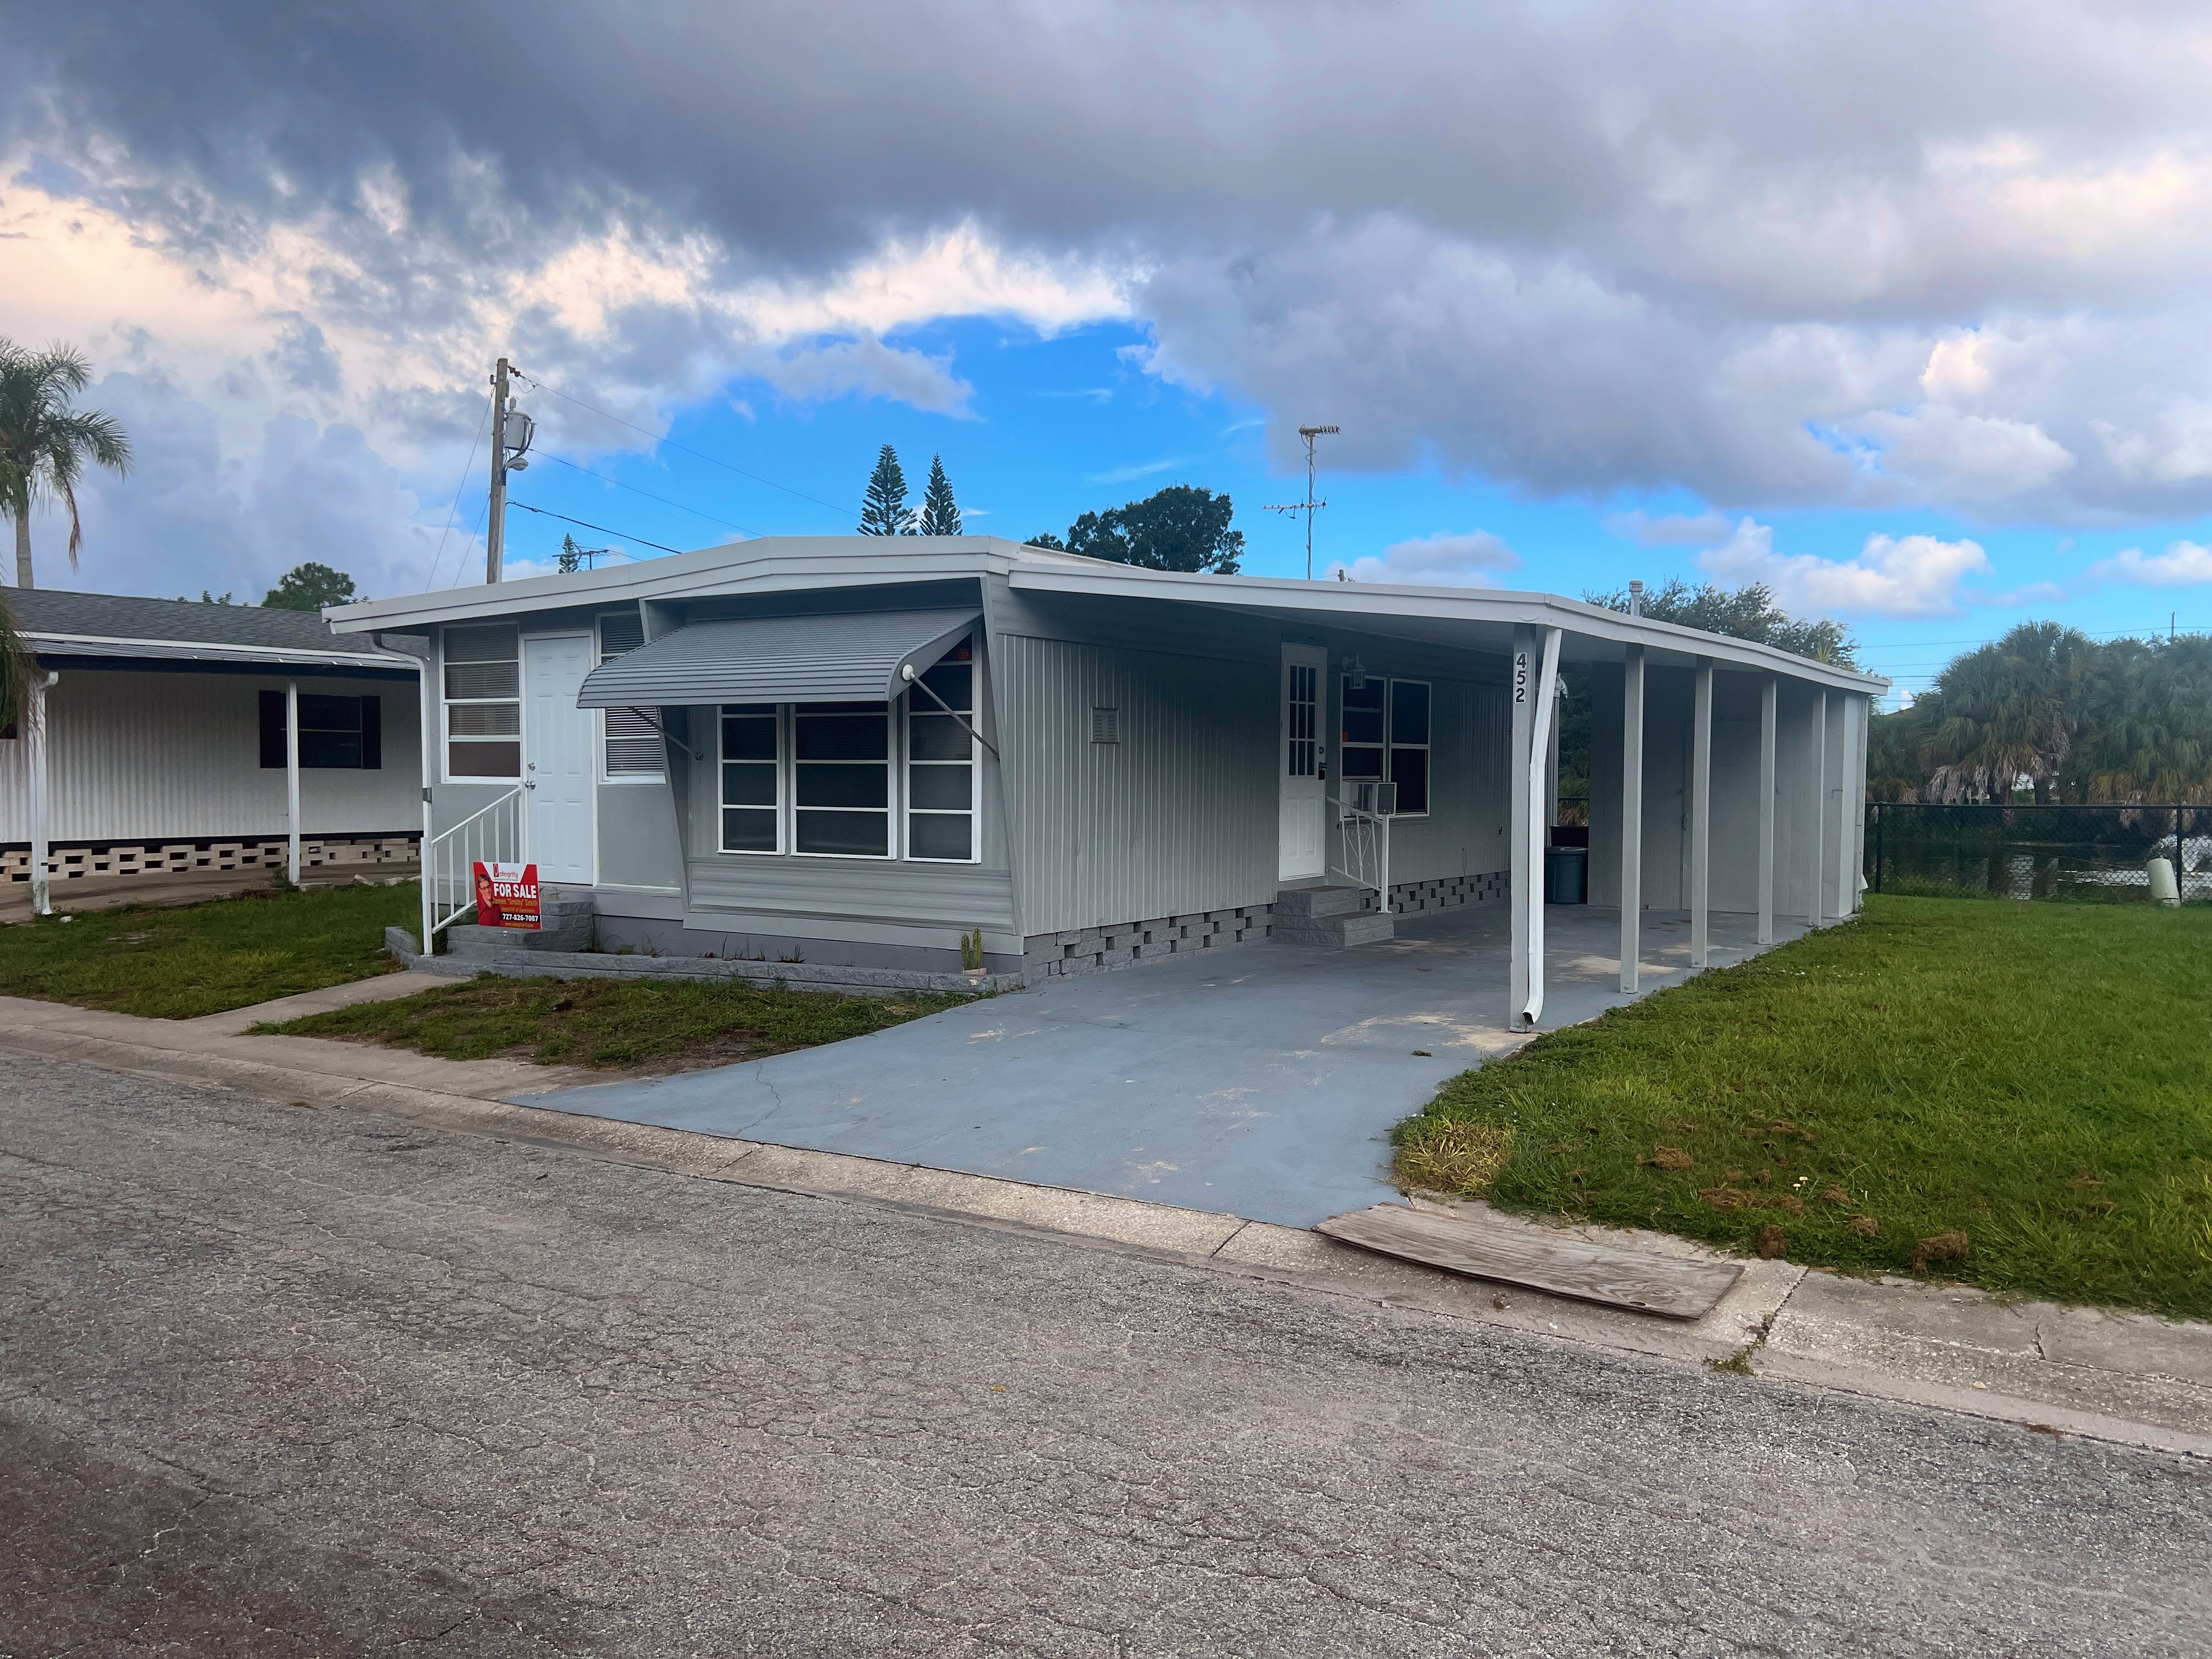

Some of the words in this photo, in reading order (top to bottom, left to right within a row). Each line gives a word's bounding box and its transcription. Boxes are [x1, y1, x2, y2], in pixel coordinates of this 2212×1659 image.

[1516, 653, 1527, 703] 452
[494, 883, 512, 897] FOR
[513, 884, 537, 899] SALE
[502, 913, 538, 922] 727-826-7087
